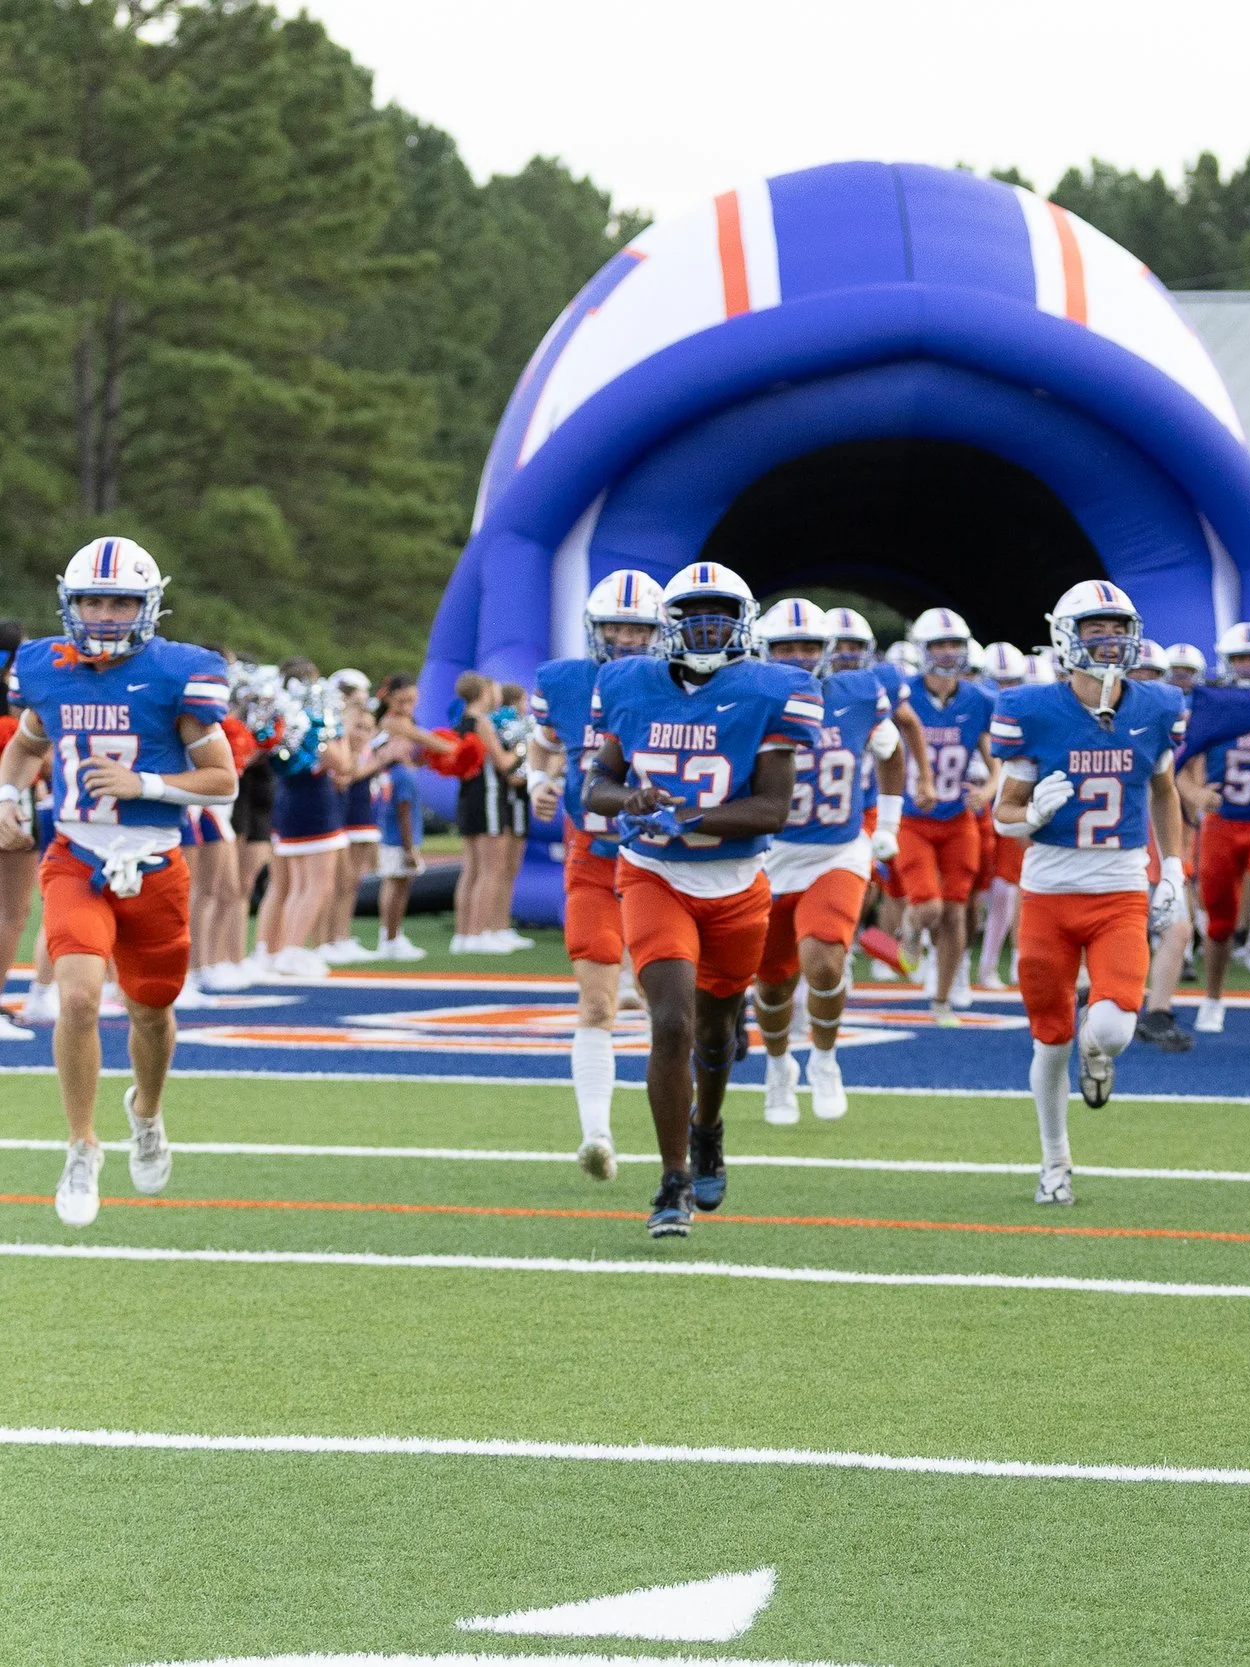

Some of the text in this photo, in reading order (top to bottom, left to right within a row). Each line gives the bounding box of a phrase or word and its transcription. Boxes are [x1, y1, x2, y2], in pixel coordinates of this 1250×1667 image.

[61, 704, 130, 731] BRUINS
[649, 722, 717, 750] BRUINS
[1069, 749, 1133, 773] BRUINS
[58, 734, 139, 824] 17
[1077, 776, 1123, 849] 2
